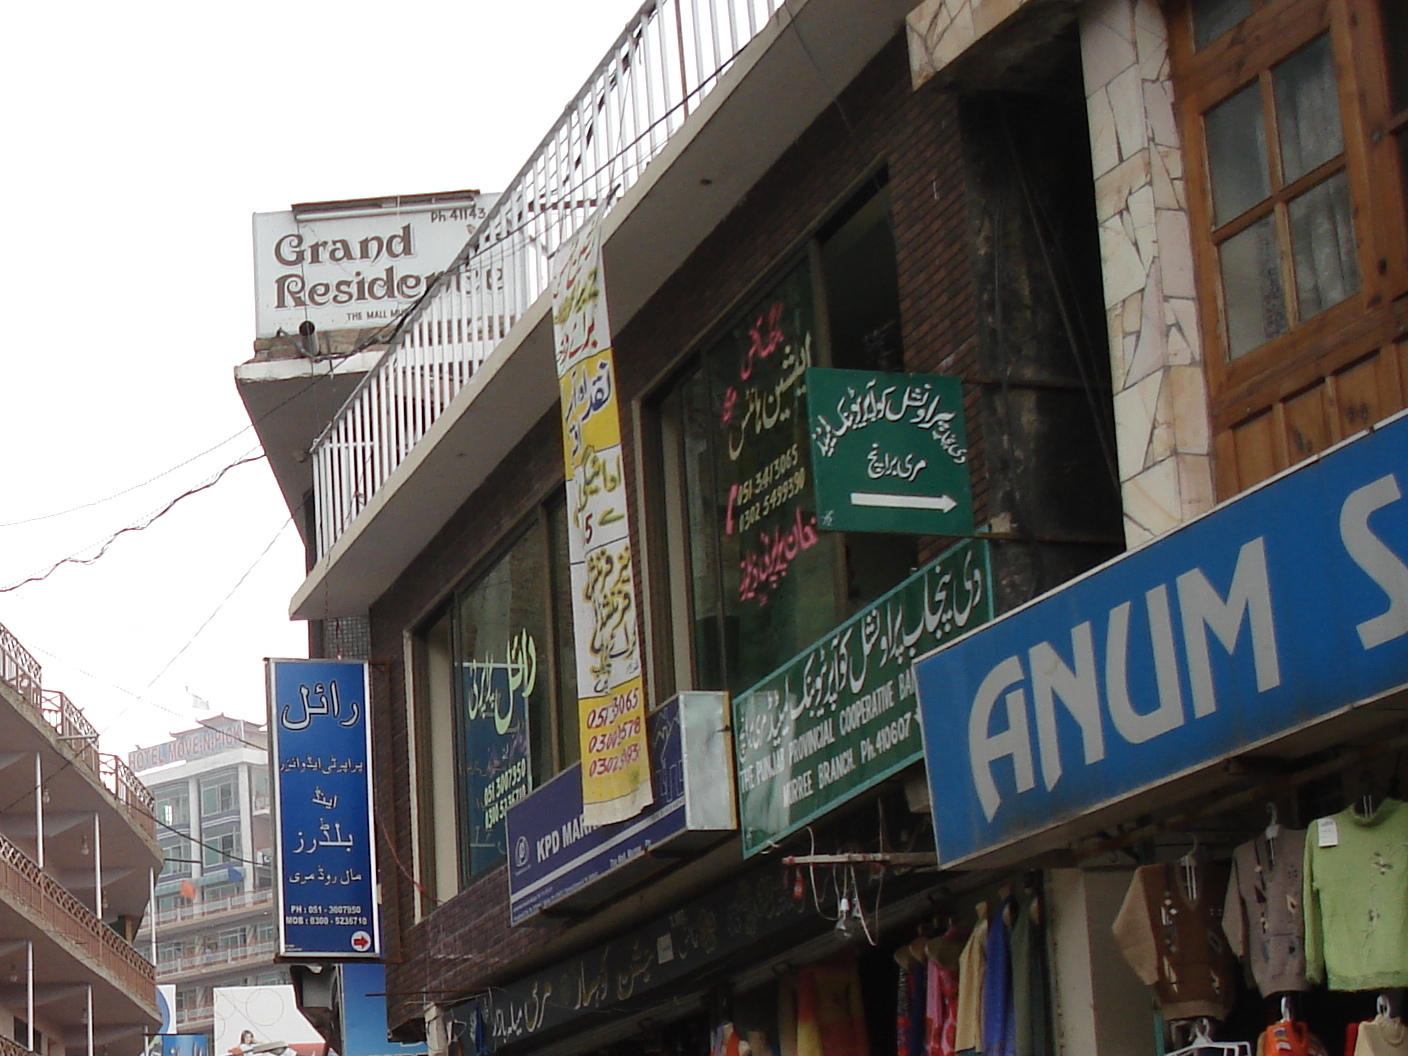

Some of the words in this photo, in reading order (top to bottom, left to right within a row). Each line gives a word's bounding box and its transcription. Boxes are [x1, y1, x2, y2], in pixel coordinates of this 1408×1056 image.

[274, 223, 413, 267] Grand
[347, 311, 362, 321] THE
[367, 309, 387, 320] MALL
[866, 443, 899, 479] برانچ
[897, 453, 927, 482] مری
[901, 565, 953, 657] پنجاب
[969, 536, 1280, 823] ANUM
[281, 680, 360, 731] رائل
[740, 765, 755, 793] THE
[756, 747, 785, 785] PUNJAB
[789, 717, 836, 767] PROVINCIAL
[839, 680, 895, 735] COOPERATIVE
[129, 746, 165, 770] HOTEL
[783, 769, 814, 807] MURREE
[293, 817, 354, 854] بلڈرز
[536, 830, 560, 863] KPD
[289, 872, 315, 885] مری
[317, 864, 337, 886] روڈ
[340, 867, 362, 886] مال
